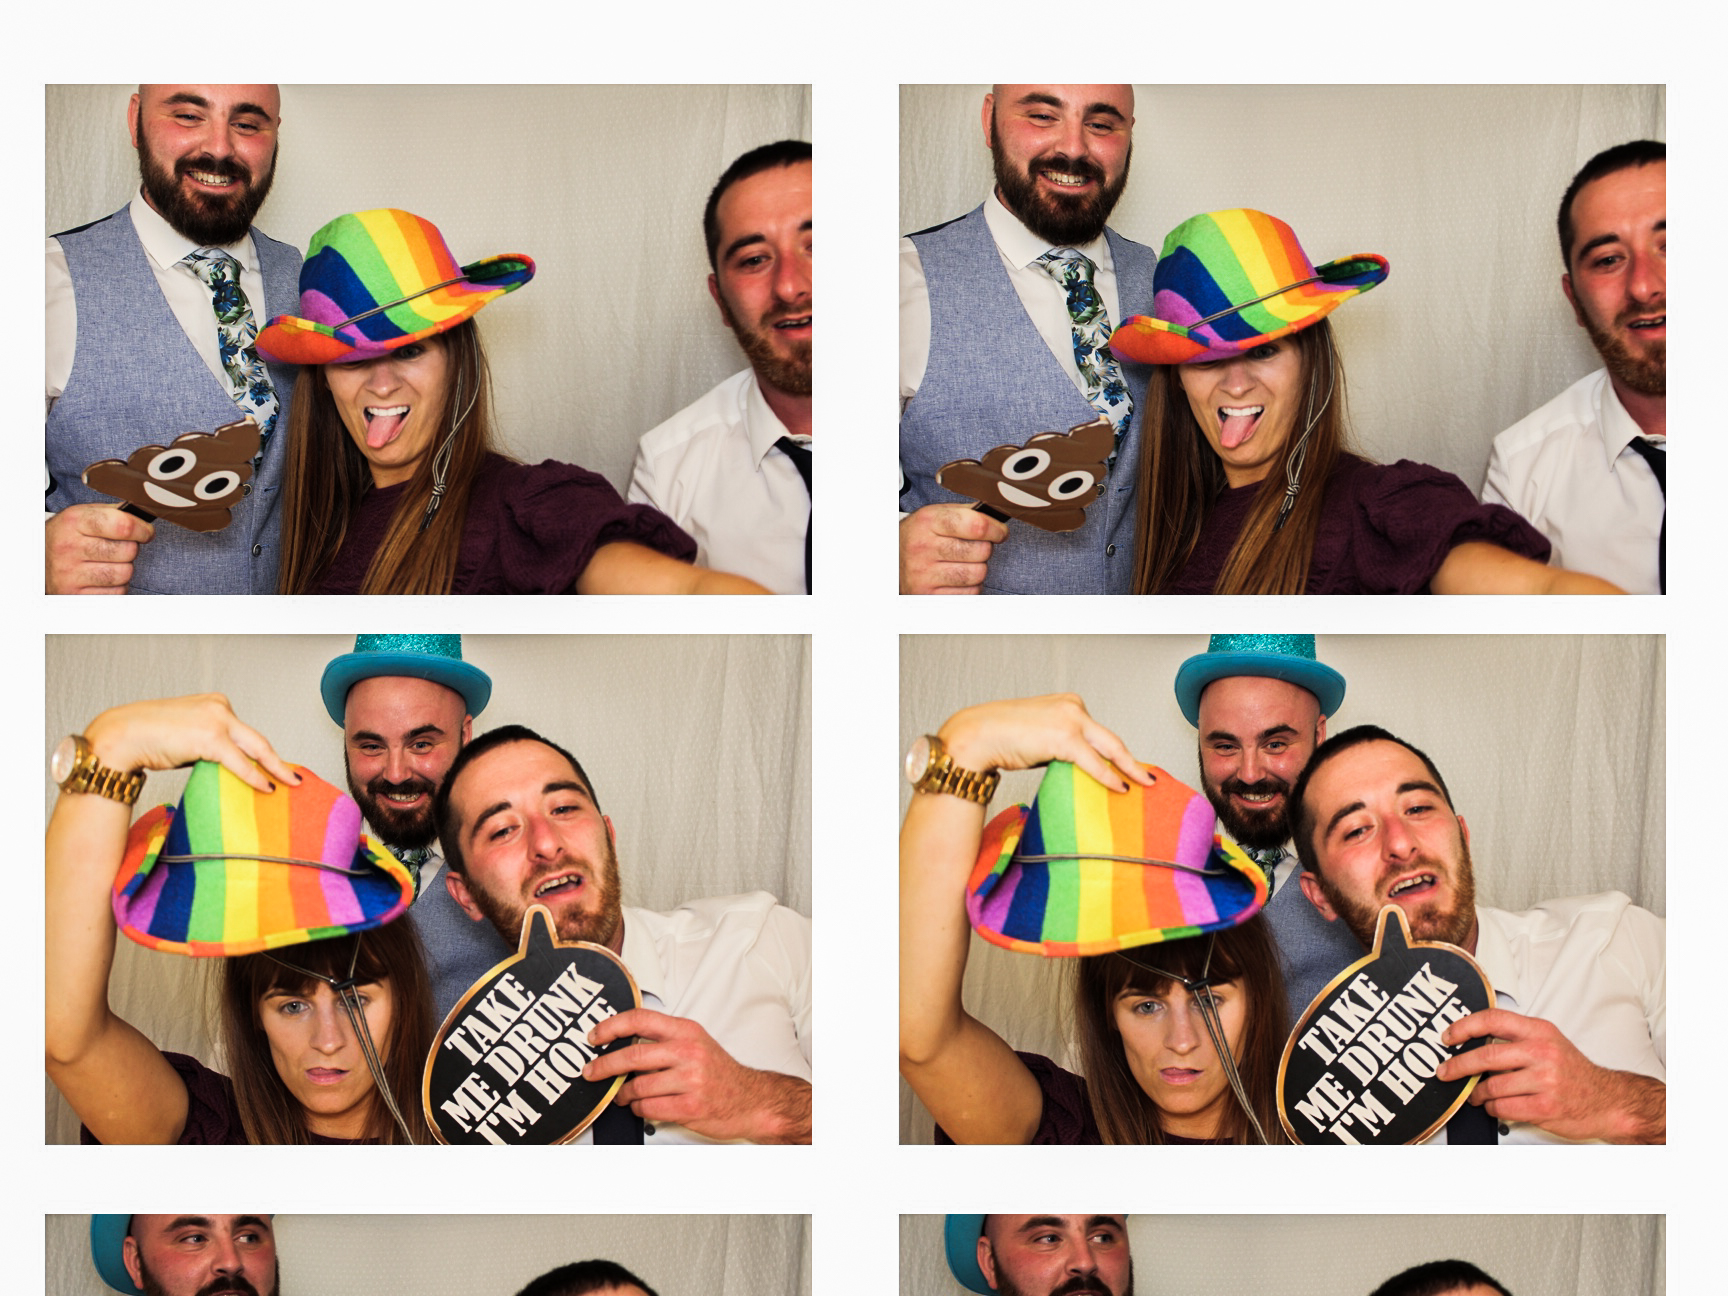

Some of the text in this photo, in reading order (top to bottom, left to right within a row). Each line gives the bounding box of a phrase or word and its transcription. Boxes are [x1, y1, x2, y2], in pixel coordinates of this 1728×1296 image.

[440, 962, 604, 1133] ME DRUNK
[444, 973, 536, 1066] TAKE
[1294, 962, 1458, 1133] ME DRUNK
[1298, 973, 1390, 1066] TAKE
[475, 1089, 543, 1145] I'M
[1329, 1089, 1397, 1145] I'M
